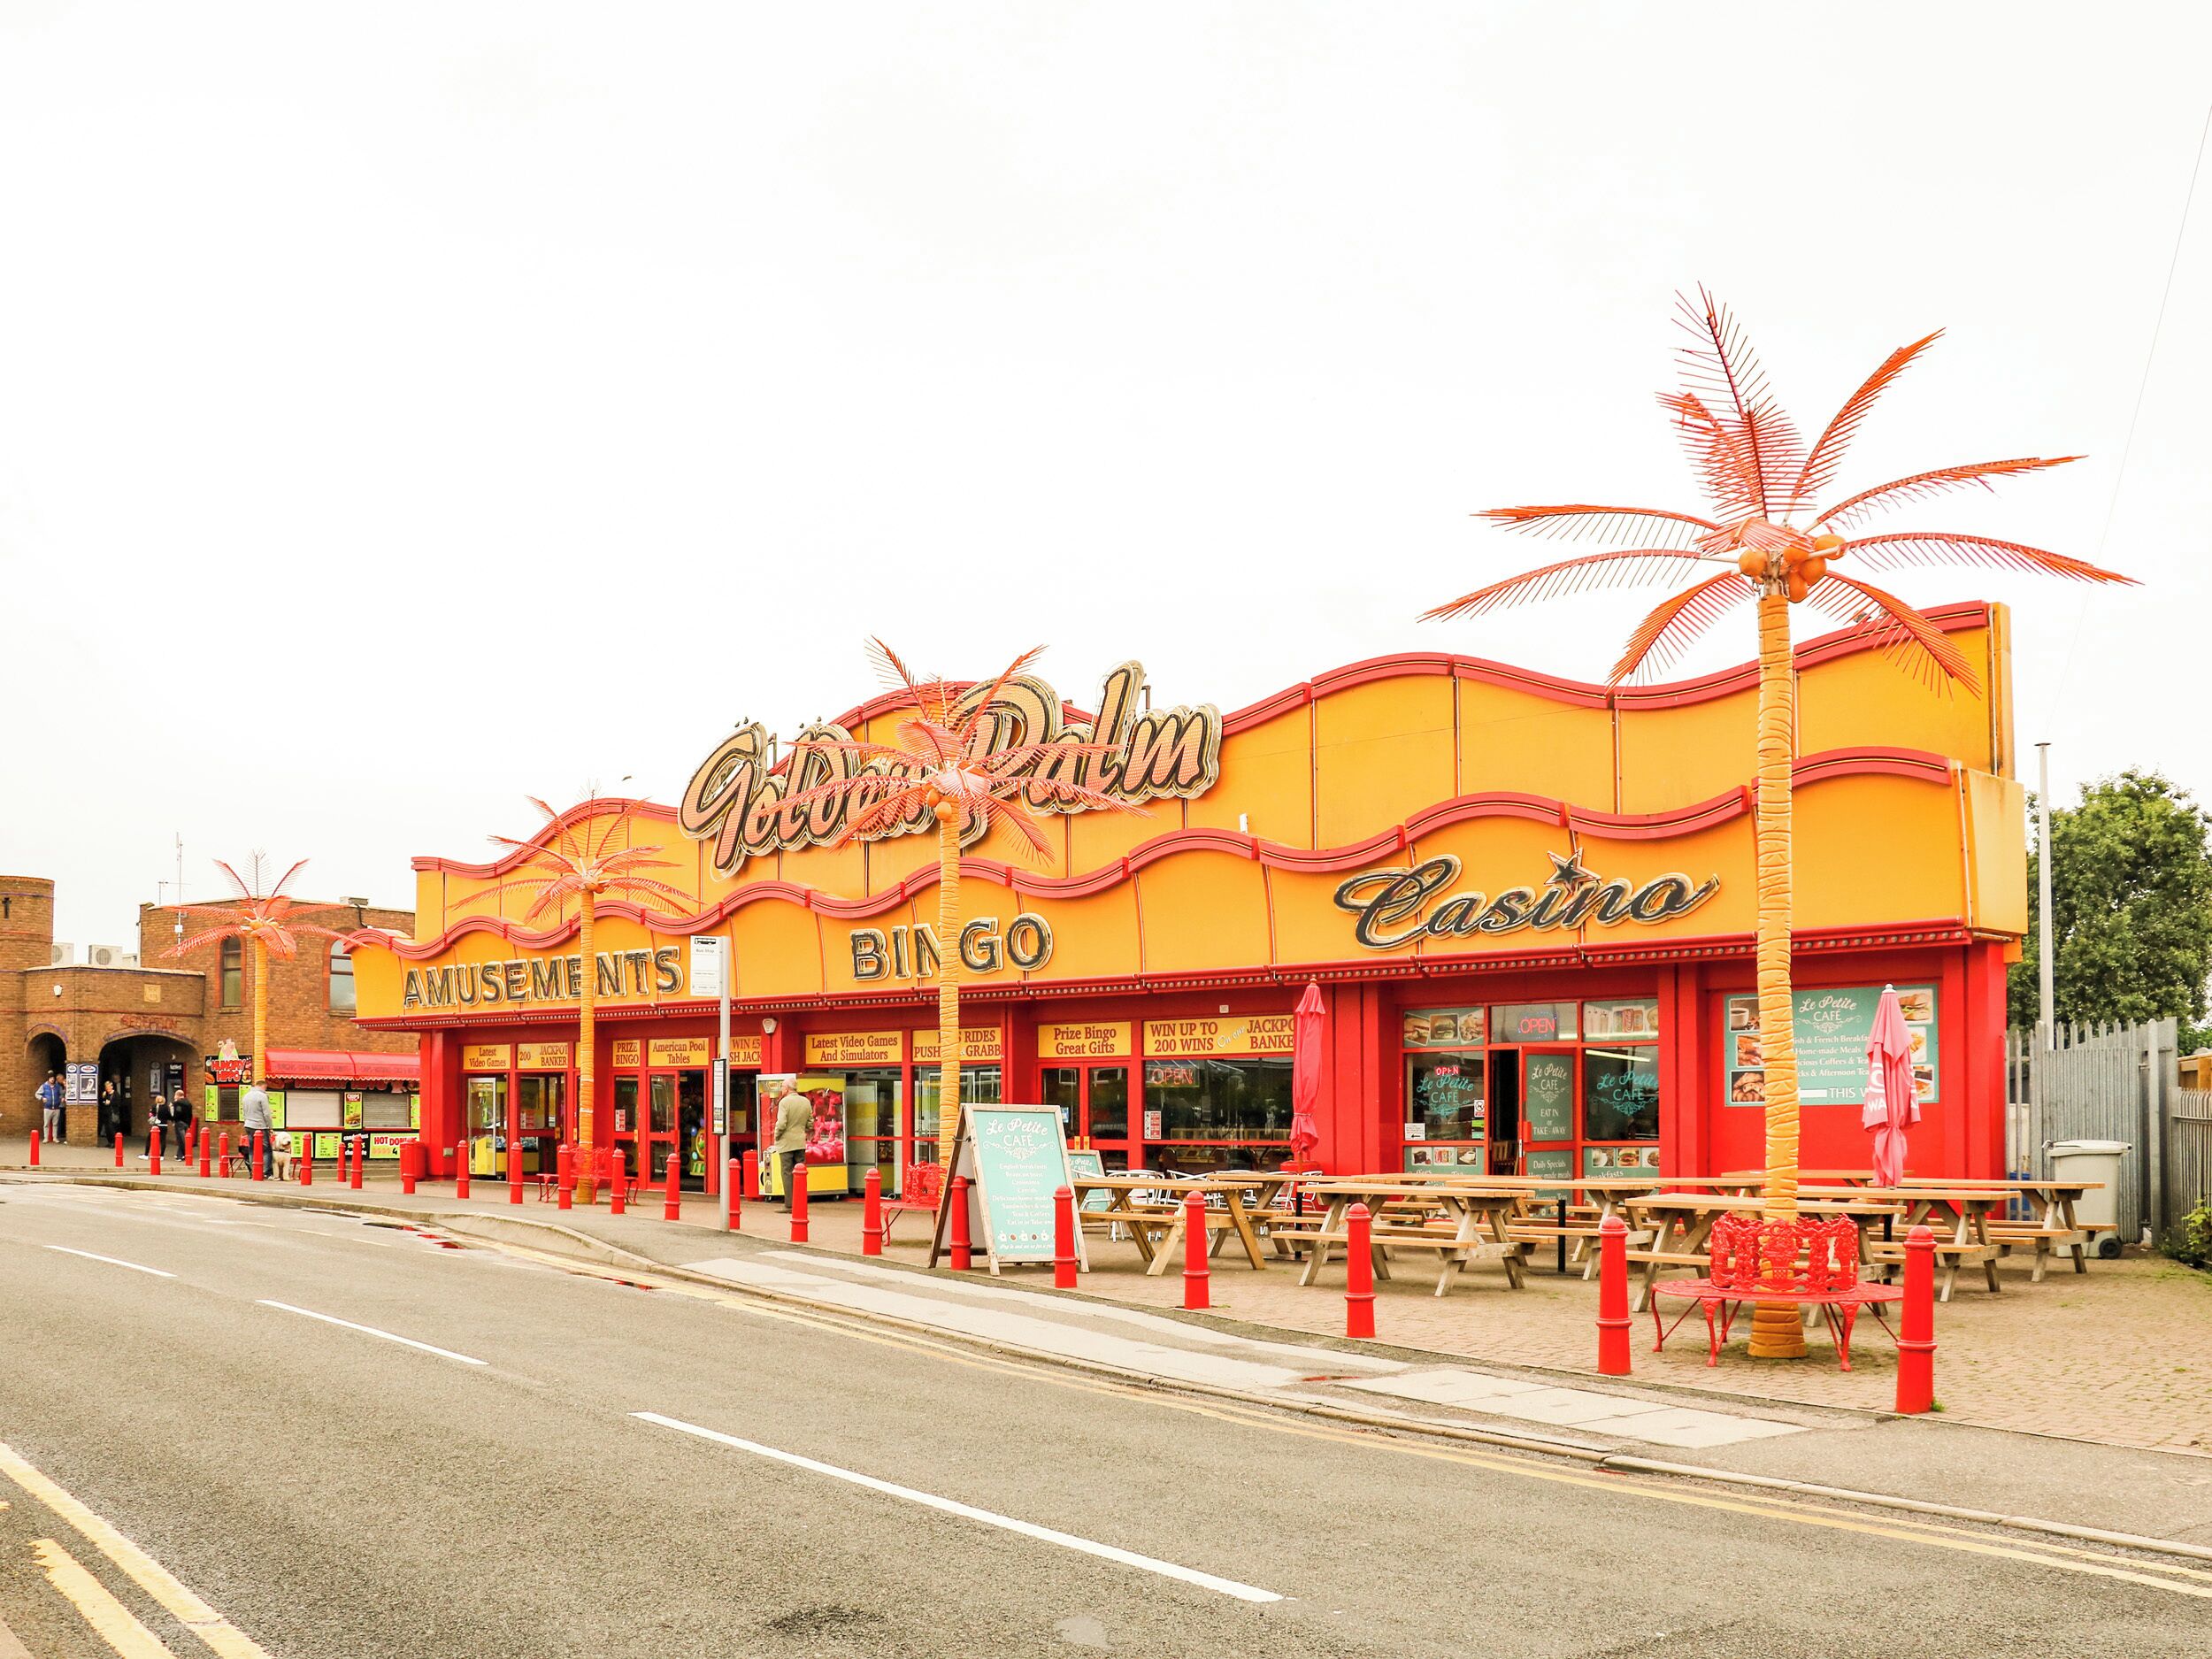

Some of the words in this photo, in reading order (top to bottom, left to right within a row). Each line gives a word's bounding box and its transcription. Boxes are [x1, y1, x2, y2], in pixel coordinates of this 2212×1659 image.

[947, 660, 1224, 849] Palm
[1333, 853, 1721, 951] Casino
[849, 912, 1054, 980] BINGO
[404, 946, 684, 1009] AMUSEMENTS
[1799, 998, 1816, 1013] Le
[1819, 995, 1857, 1011] Petite
[1813, 1008, 1842, 1021] CAFÉ
[1151, 1023, 1176, 1037] WIN
[1180, 1023, 1197, 1035] UP
[1199, 1022, 1218, 1034] TO
[1519, 1018, 1555, 1033] OPEN
[964, 1030, 995, 1042] RIDES
[1053, 1027, 1081, 1041] Prize
[1084, 1026, 1117, 1042] Bingo
[617, 1042, 637, 1053] PRIZE
[652, 1041, 688, 1052] American
[689, 1040, 706, 1051] Pool
[732, 1038, 750, 1049] WIN
[811, 1037, 837, 1049] Latest
[840, 1036, 864, 1047] Video
[867, 1035, 898, 1047] Games
[1056, 1041, 1087, 1055] Great
[1088, 1041, 1115, 1054] Gifts
[1154, 1039, 1177, 1053] 200
[1181, 1037, 1214, 1051] WINS
[479, 1047, 496, 1056] Latest
[519, 1052, 531, 1061] 200
[667, 1053, 691, 1064] Tables
[820, 1050, 838, 1061] And
[841, 1049, 888, 1060] Simulators
[469, 1058, 485, 1068] Video
[487, 1057, 506, 1067] Games
[541, 1056, 567, 1067] BANKER
[615, 1054, 639, 1064] BINGO
[1152, 1068, 1193, 1086] OPEN
[1532, 1064, 1543, 1080] Le
[1545, 1063, 1567, 1080] Petite
[1819, 1068, 1855, 1076] Afternoon
[1417, 1076, 1433, 1093] Le
[1436, 1075, 1474, 1092] Petite
[1597, 1073, 1615, 1090] Le
[1829, 1087, 1856, 1098] THIS
[1541, 1109, 1552, 1117] EAT
[987, 1118, 1004, 1135] Le
[1007, 1118, 1048, 1136] Petite
[1003, 1132, 1034, 1147] CAFÉ
[1533, 1160, 1546, 1170] Daily
[1547, 1160, 1566, 1169] Specials
